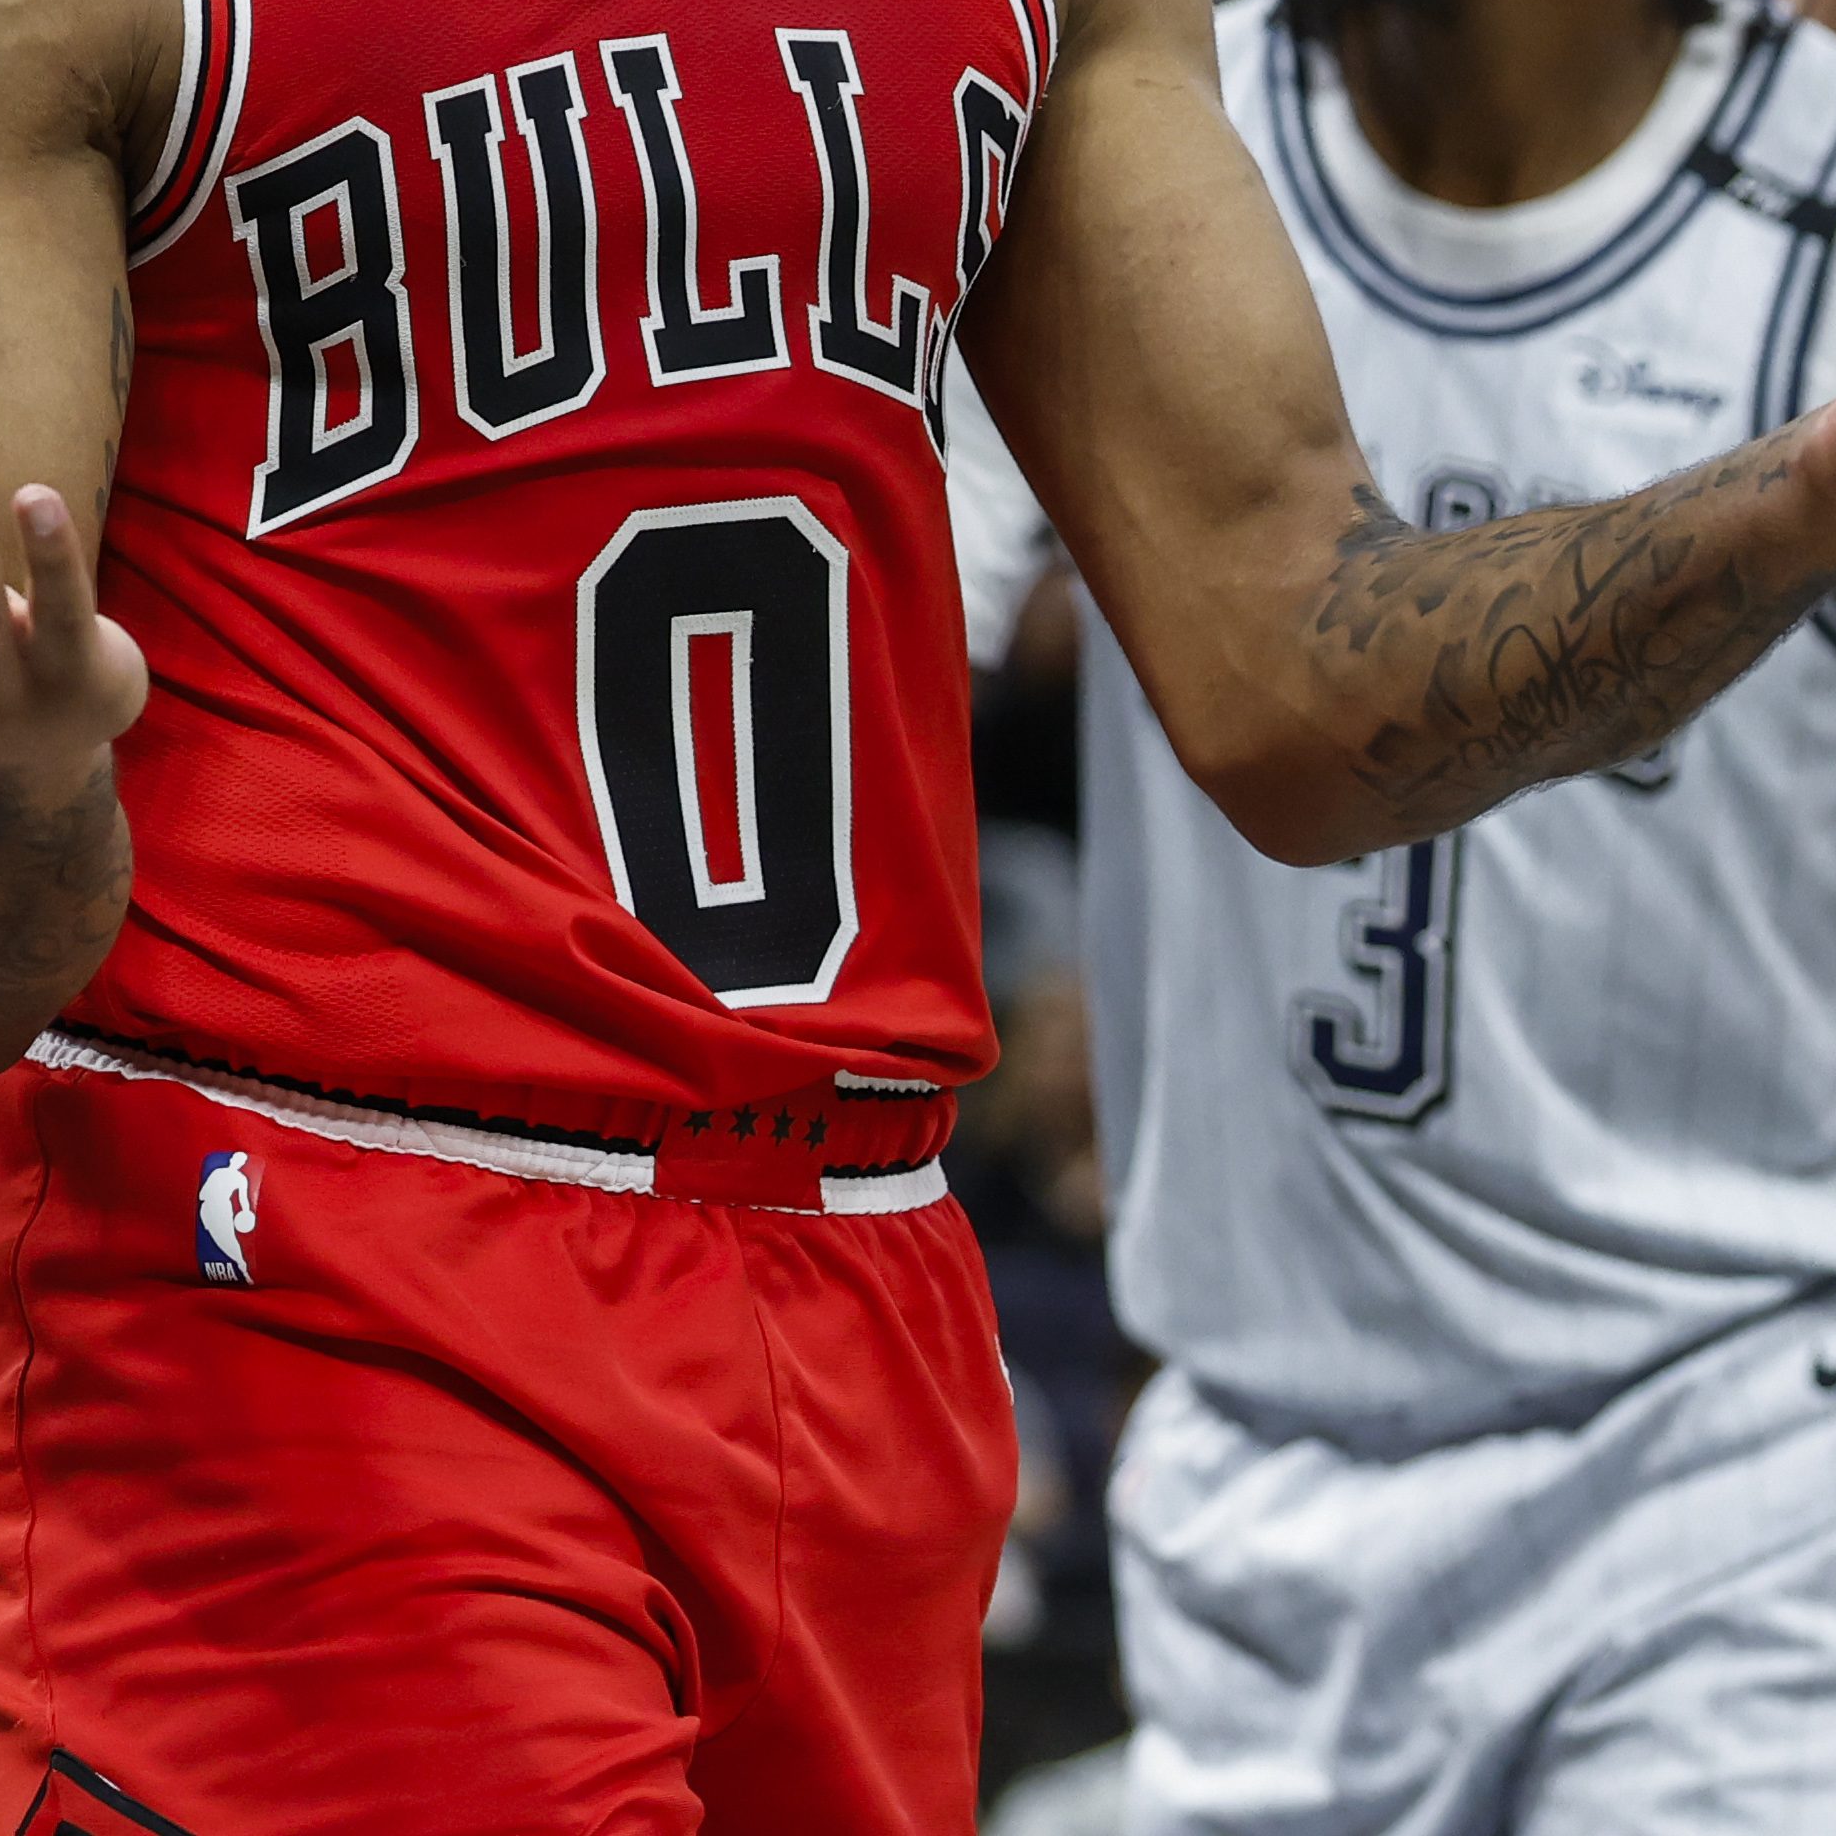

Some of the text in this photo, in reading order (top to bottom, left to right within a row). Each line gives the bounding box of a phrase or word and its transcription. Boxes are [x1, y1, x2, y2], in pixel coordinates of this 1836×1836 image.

[575, 494, 861, 1010] 0
[1289, 826, 1460, 1127] 3
[203, 1261, 239, 1282] NBA
